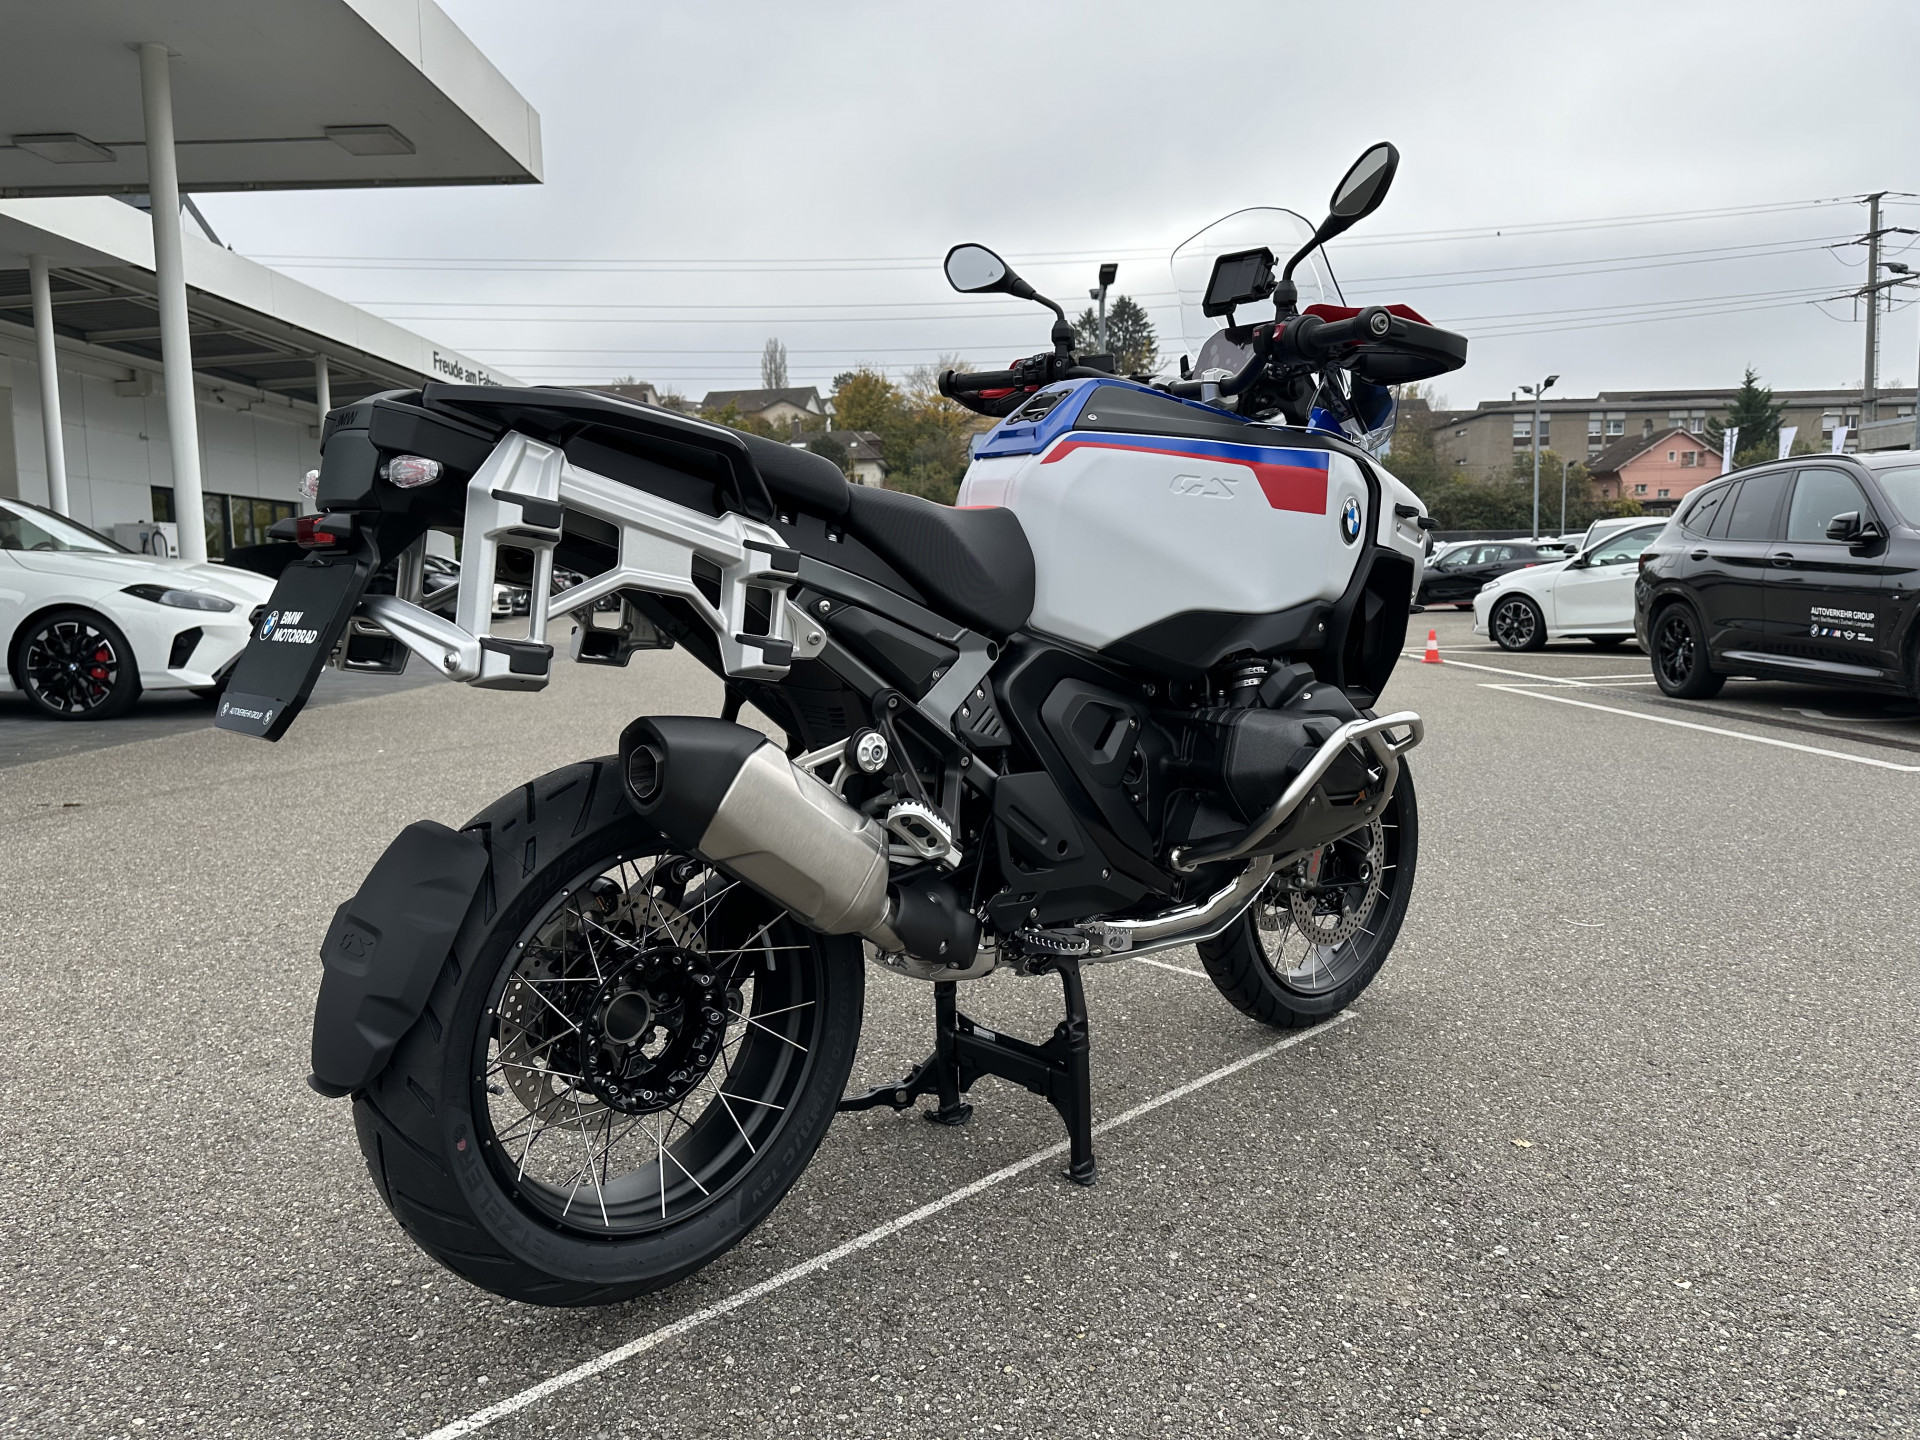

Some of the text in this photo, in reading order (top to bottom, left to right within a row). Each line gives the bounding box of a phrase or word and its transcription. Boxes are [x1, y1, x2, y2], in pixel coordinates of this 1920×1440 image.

[433, 350, 503, 386] Freude am Fah
[1169, 474, 1239, 500] GS
[280, 611, 304, 625] BMW
[1811, 606, 1875, 621] AUTOVERKEHR GROUP
[272, 628, 317, 644] MOTORRAD
